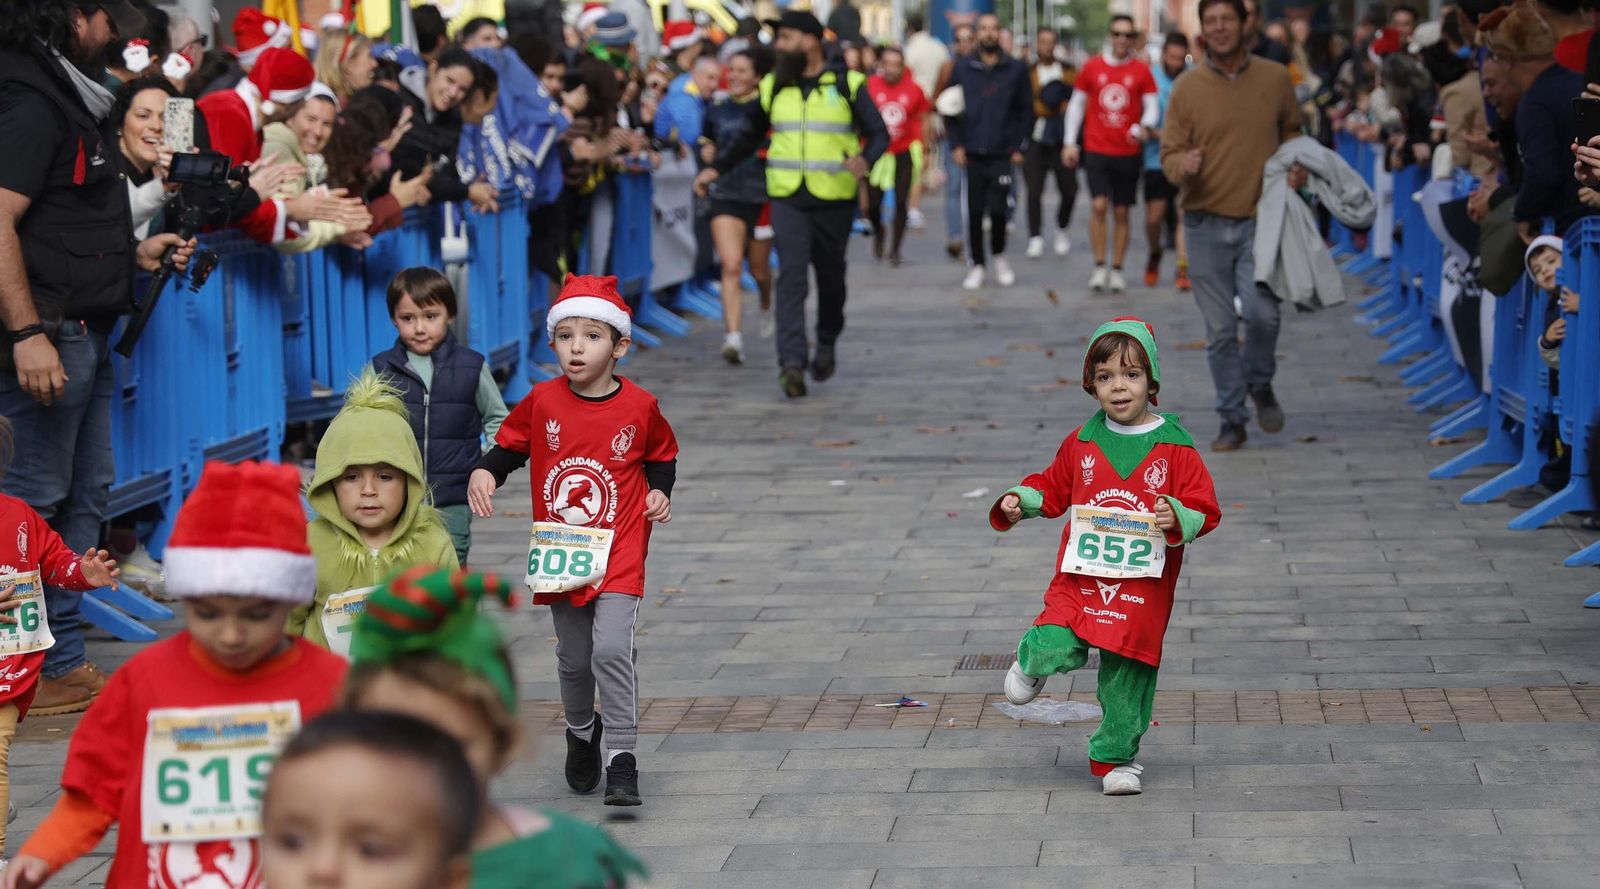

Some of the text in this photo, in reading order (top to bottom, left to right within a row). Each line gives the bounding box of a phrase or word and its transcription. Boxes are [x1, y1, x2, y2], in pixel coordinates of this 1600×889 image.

[559, 457, 604, 473] SOLIDARIA
[601, 469, 613, 482] DE
[543, 465, 561, 501] CARRERA
[606, 481, 618, 523] NAVIDAD
[1095, 488, 1138, 505] SOLIDARIA
[1077, 532, 1152, 567] 652
[527, 547, 594, 577] 608
[1120, 593, 1145, 604] EVOS
[1083, 606, 1127, 621] CUPRA
[157, 753, 275, 806] 619
